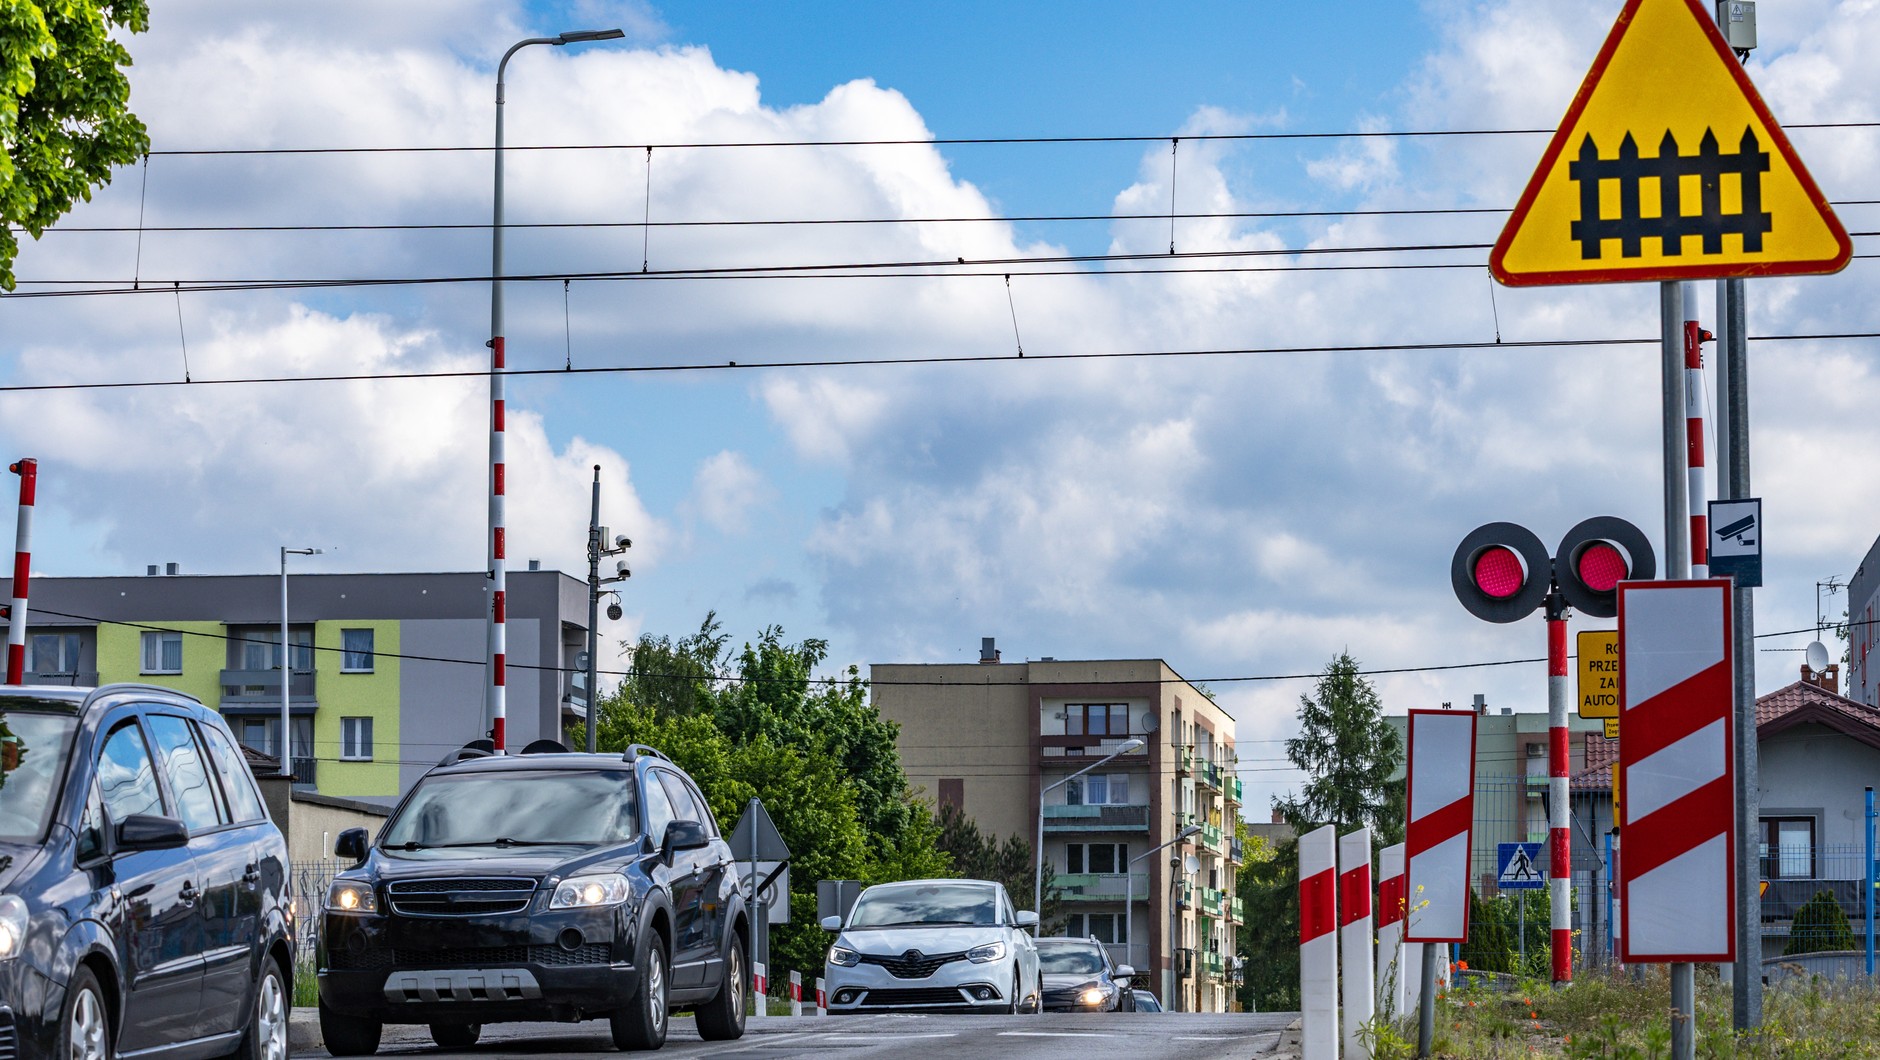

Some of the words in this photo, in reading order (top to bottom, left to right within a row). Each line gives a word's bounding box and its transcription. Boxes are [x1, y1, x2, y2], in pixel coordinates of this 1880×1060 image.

[1590, 660, 1618, 672] PRZE
[1600, 677, 1618, 689] ZA
[1584, 694, 1618, 706] AUTO
